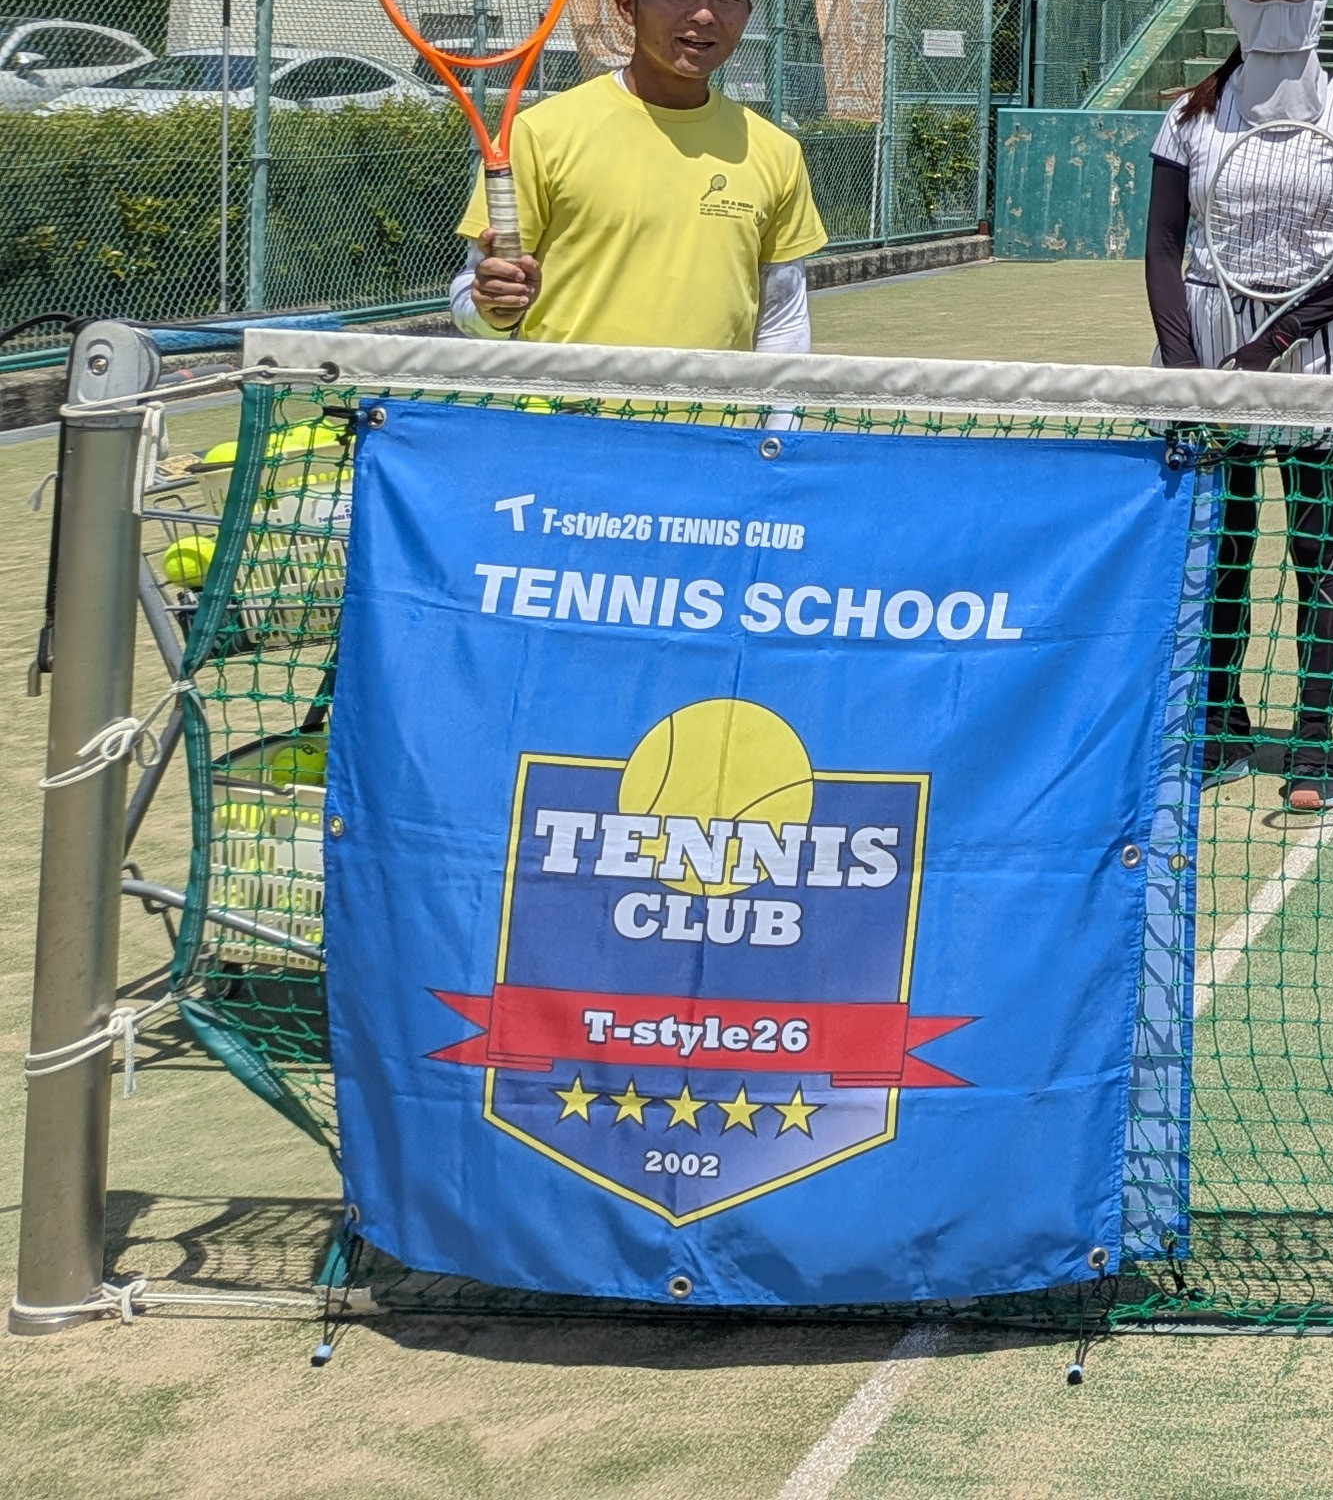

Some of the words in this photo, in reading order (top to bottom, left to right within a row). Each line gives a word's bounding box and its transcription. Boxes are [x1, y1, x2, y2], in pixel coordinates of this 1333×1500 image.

[541, 508, 653, 541] T-style26
[658, 516, 740, 547] TENNIS
[745, 521, 806, 550] CLUB
[474, 563, 725, 629] TENNIS
[739, 582, 1023, 641] SCHOOL
[534, 809, 900, 888] TENNIS
[613, 892, 802, 946] CLUB
[584, 1010, 809, 1056] T-style26
[644, 1150, 721, 1178] 2002
